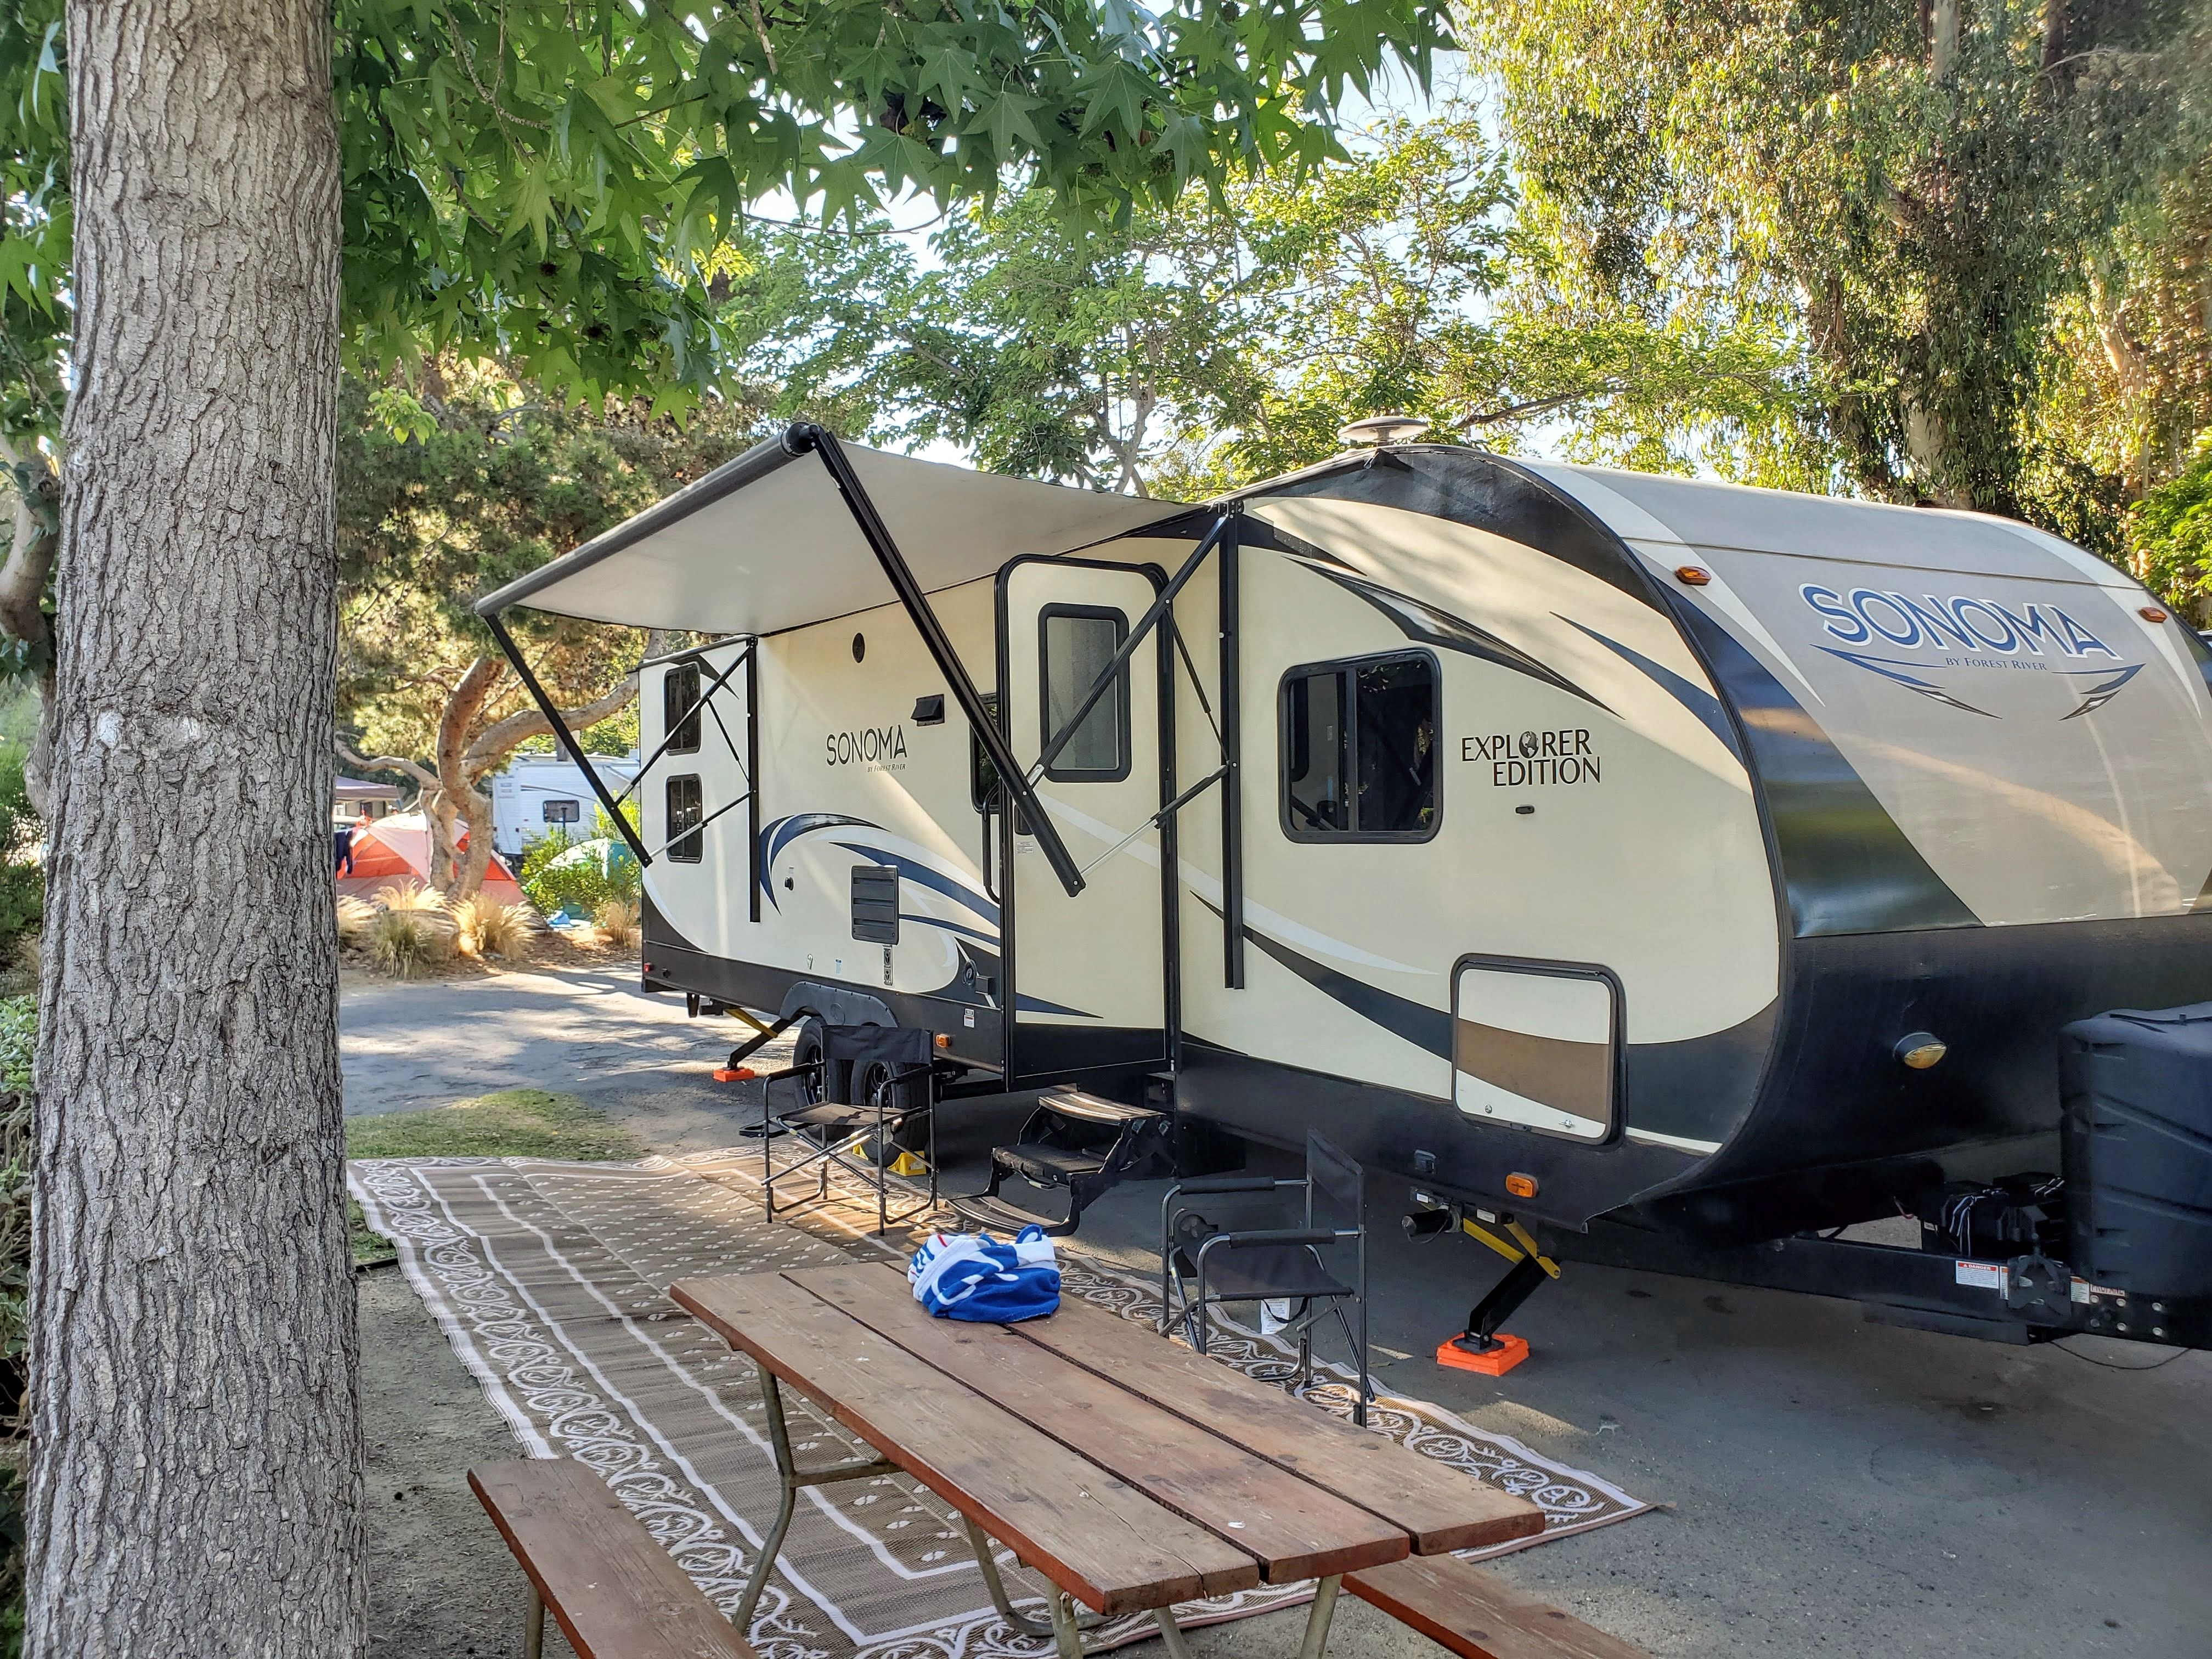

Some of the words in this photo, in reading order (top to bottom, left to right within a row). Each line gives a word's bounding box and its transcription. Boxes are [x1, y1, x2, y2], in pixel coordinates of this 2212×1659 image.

[1798, 583, 2123, 661] SONOMA
[1945, 657, 1960, 666] BY
[1964, 657, 2007, 668] FOREST
[2012, 660, 2047, 670] RIVER
[826, 724, 907, 766] SONOMA
[1461, 729, 1593, 761] EXPLORER
[1493, 756, 1601, 786] EDITION
